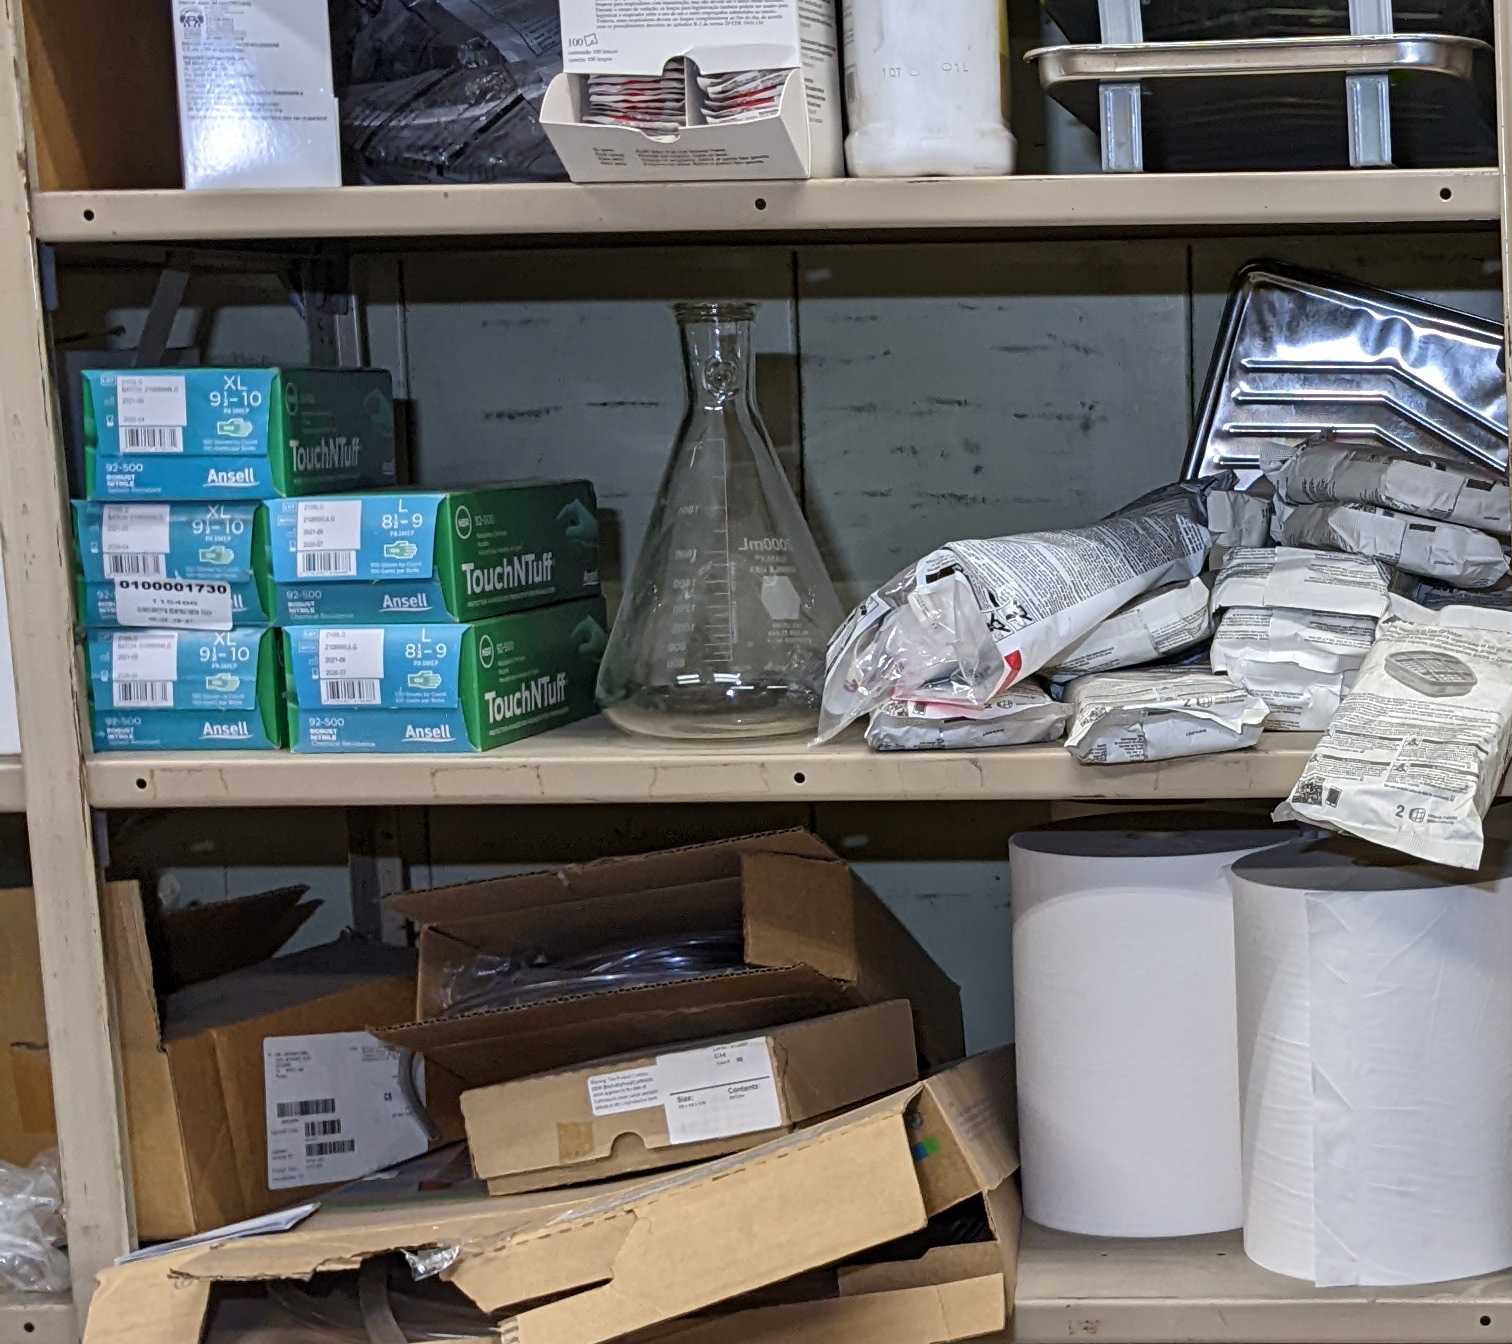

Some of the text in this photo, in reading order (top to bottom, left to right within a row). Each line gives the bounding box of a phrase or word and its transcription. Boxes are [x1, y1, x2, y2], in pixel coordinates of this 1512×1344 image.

[568, 37, 583, 47] 100
[224, 376, 247, 390] XL
[290, 436, 360, 471] TouchNTuff
[208, 468, 254, 484] Ansell
[208, 505, 230, 518] XL
[399, 499, 408, 513] L
[462, 551, 554, 594] TouchNTuff
[120, 580, 227, 594] 0100001730
[383, 593, 428, 608] Ansell
[214, 632, 236, 646] XL
[422, 628, 431, 642] L
[484, 676, 568, 724] TouchNTuff
[203, 721, 248, 736] Ansell
[309, 718, 344, 727] 92-500
[405, 724, 450, 739] Ansell
